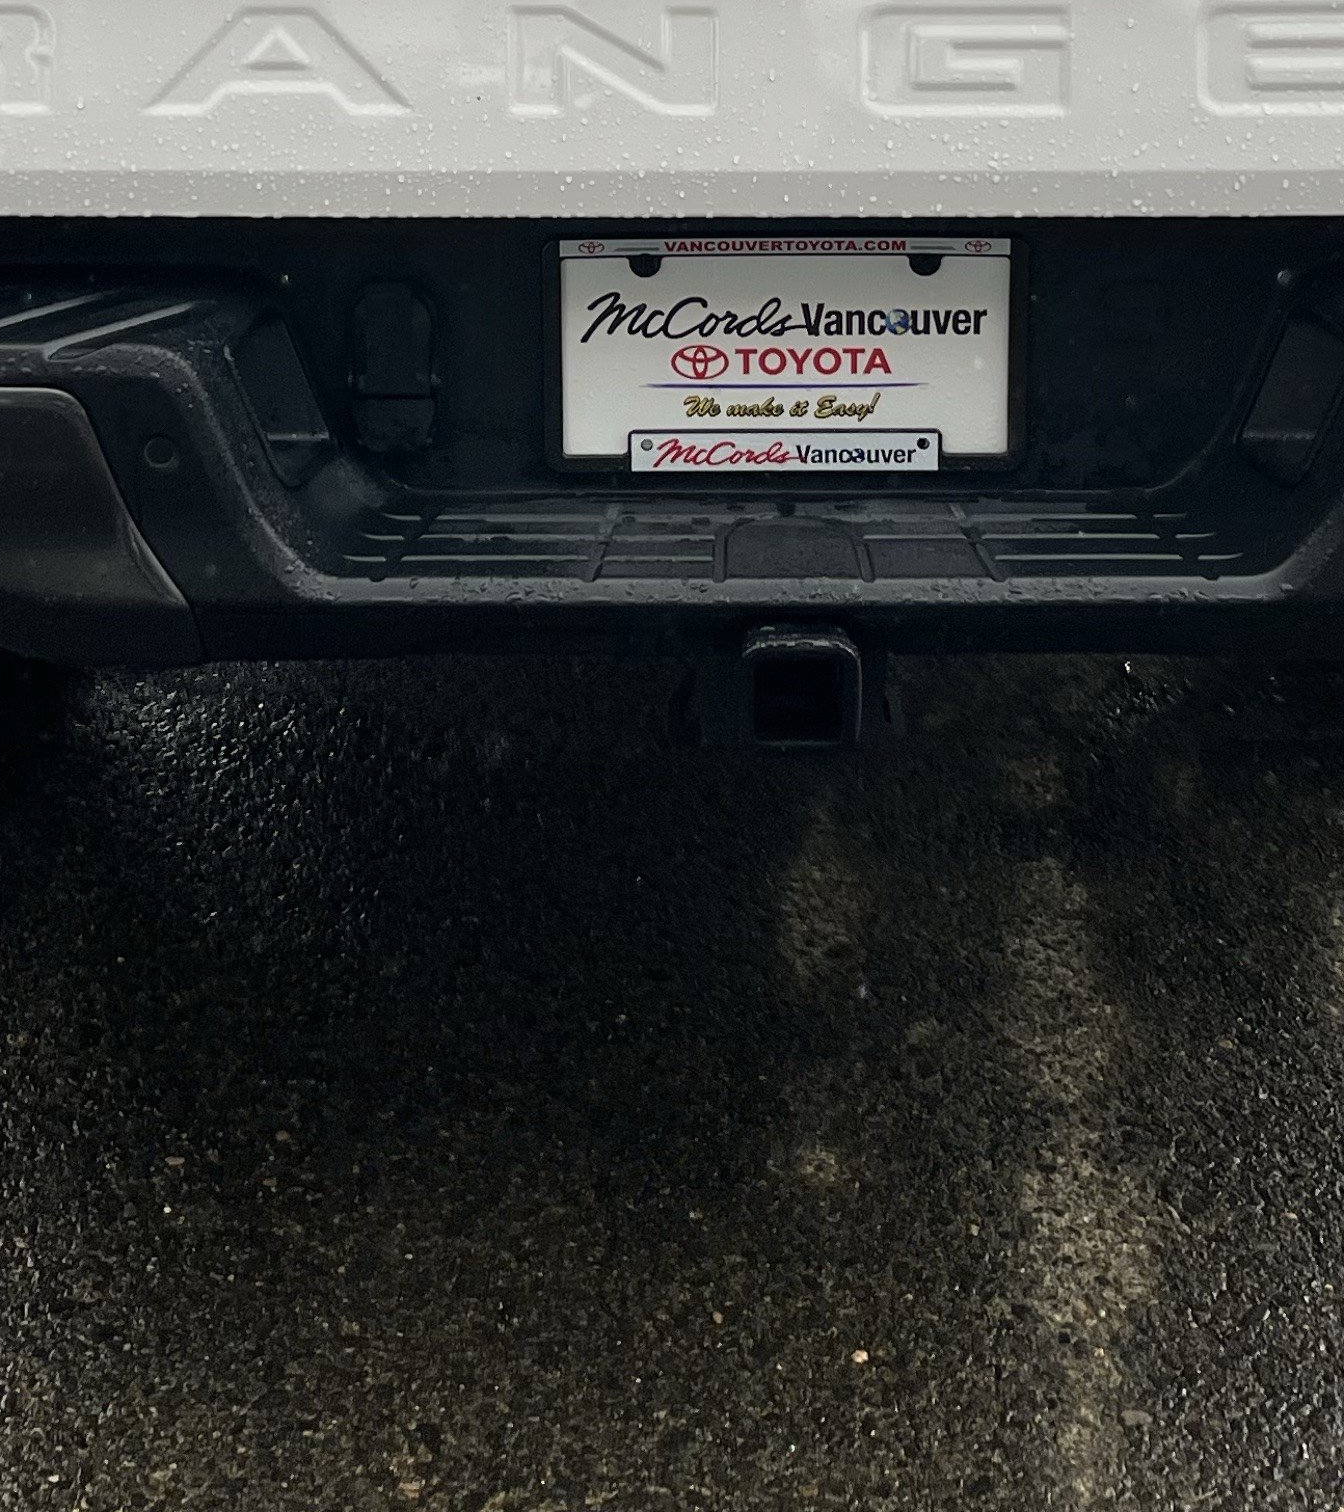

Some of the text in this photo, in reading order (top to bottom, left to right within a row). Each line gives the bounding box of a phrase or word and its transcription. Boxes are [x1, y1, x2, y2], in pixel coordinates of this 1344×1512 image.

[664, 240, 907, 253] VANCOUVERTOYOTA.COM
[734, 347, 892, 376] TOYOTA
[683, 392, 881, 422] We make it Easy!
